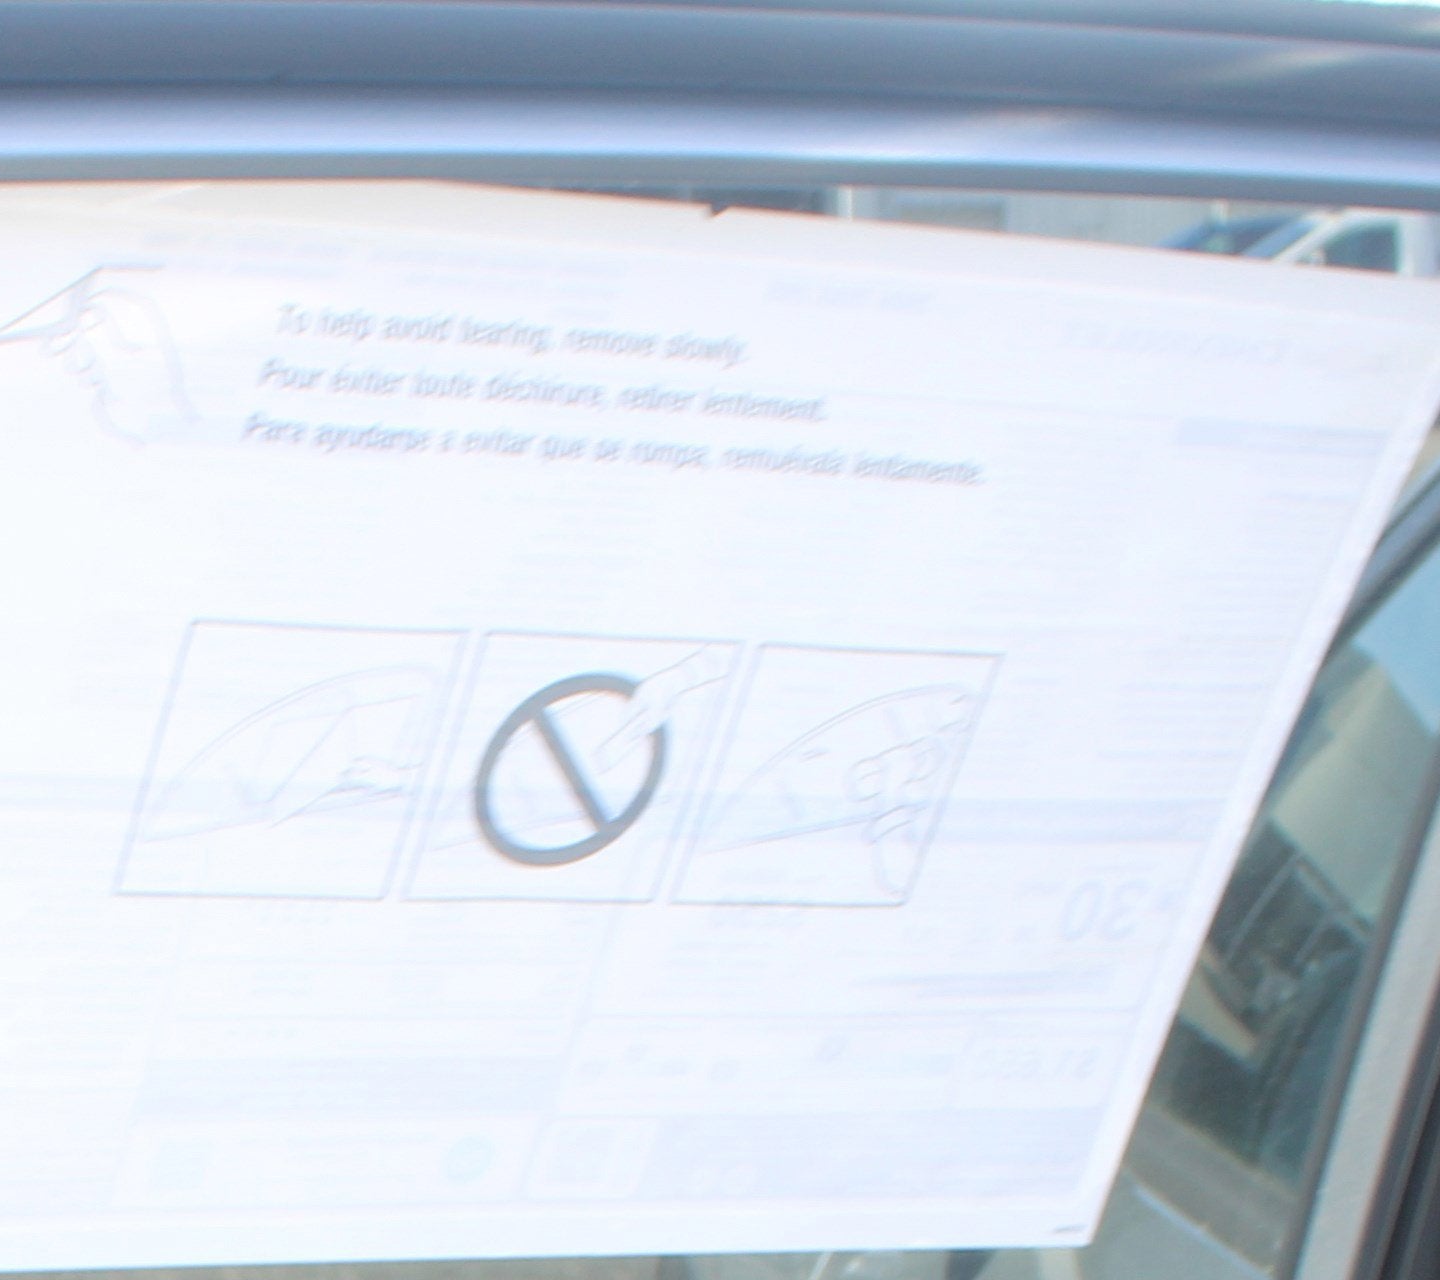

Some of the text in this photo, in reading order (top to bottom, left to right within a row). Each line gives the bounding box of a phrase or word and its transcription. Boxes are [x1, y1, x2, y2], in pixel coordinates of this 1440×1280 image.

[277, 303, 309, 335] To
[314, 308, 375, 342] help
[381, 311, 456, 343] avoid
[563, 328, 658, 357] remove
[259, 357, 326, 391] Pour
[241, 410, 308, 445] Para
